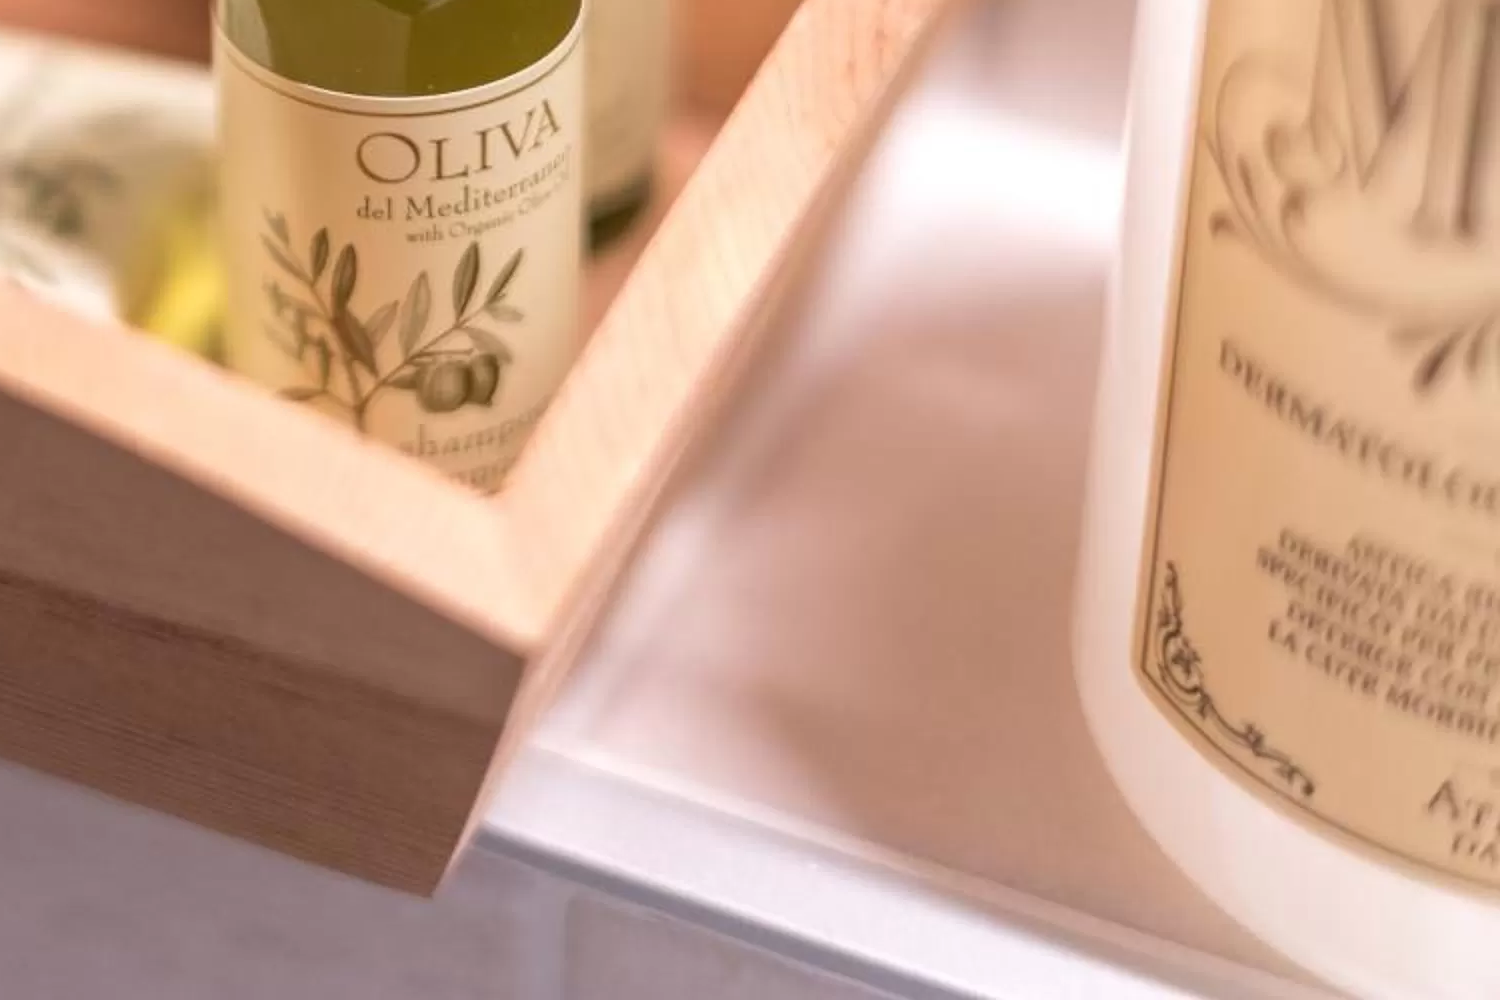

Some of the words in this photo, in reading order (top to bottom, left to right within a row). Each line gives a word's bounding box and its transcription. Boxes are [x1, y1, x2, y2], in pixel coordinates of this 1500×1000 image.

[355, 97, 561, 184] OLIVA
[355, 194, 393, 221] del
[405, 222, 444, 245] with
[1267, 617, 1298, 653] LA
